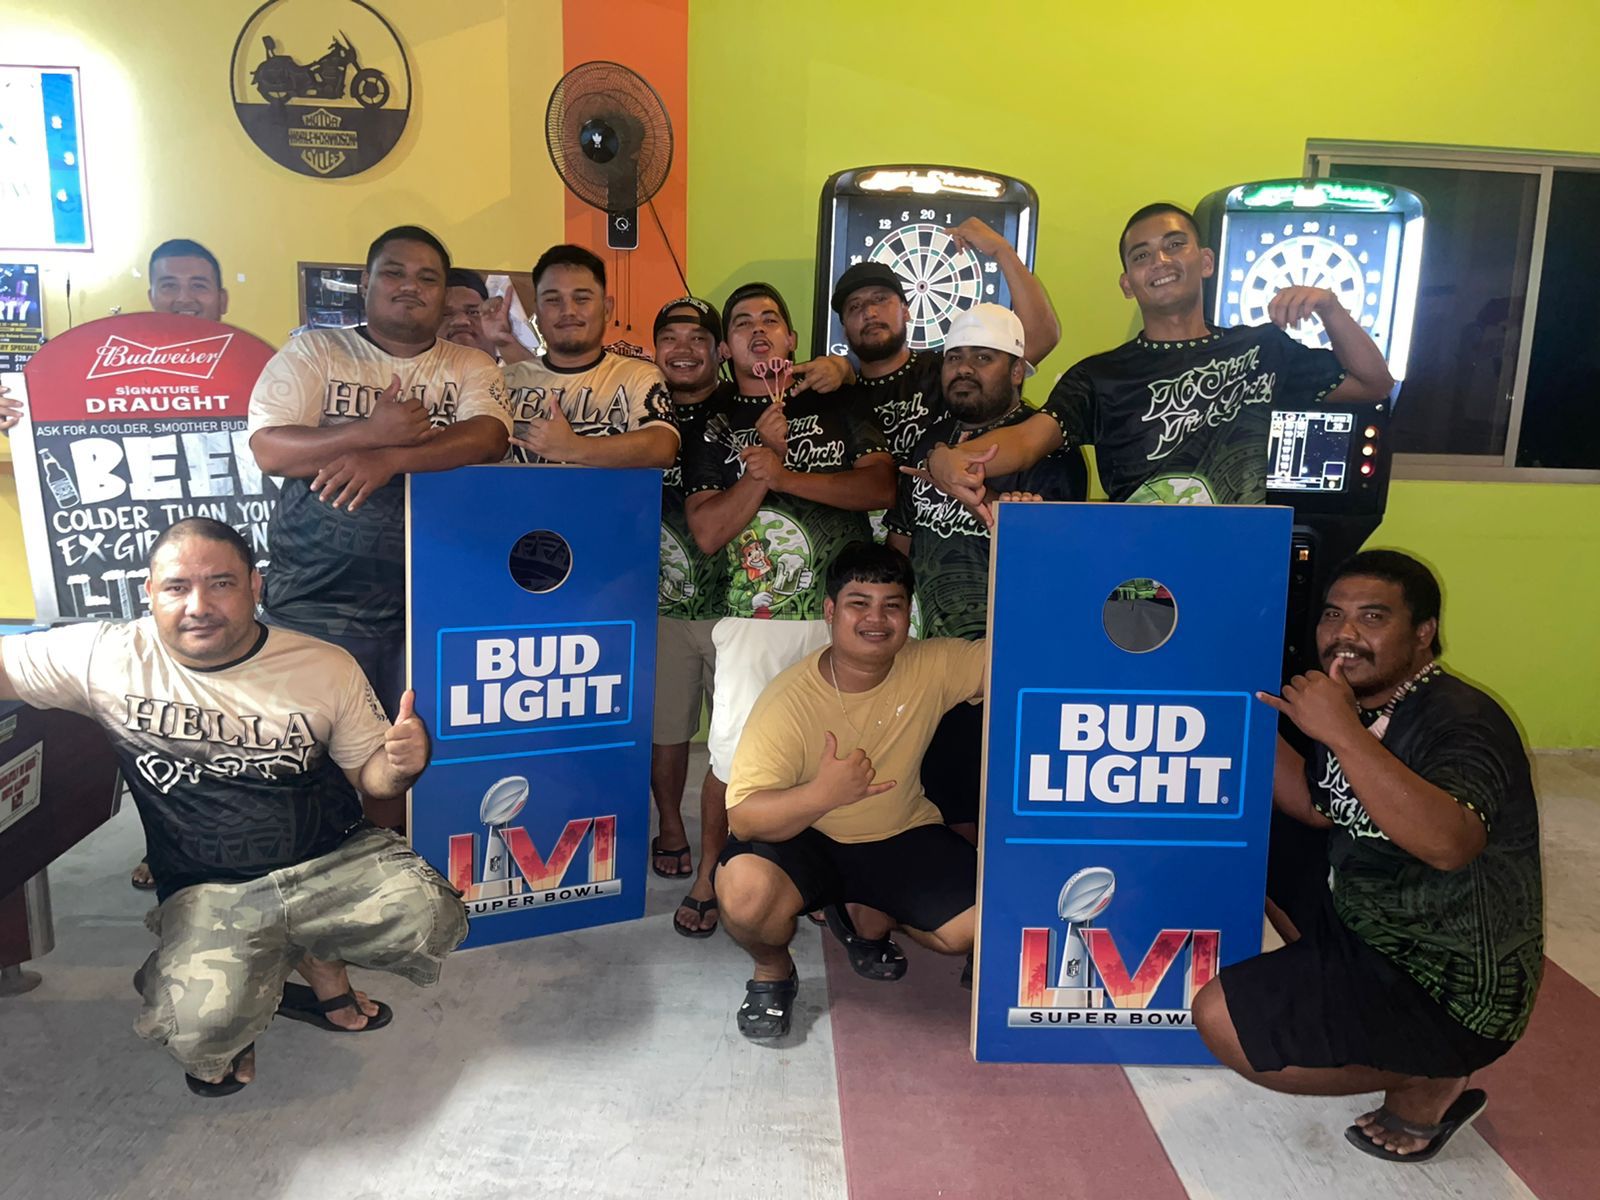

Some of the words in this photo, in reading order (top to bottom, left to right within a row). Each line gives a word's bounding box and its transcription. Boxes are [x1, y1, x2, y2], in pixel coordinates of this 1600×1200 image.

[879, 219, 892, 229] 12
[901, 212, 909, 221] 5
[920, 209, 935, 219] 20
[946, 213, 951, 223] 1
[865, 236, 873, 246] 9
[986, 283, 994, 294] 6
[96, 345, 219, 367] Budweiser
[86, 395, 230, 413] DRAUGHT
[115, 385, 200, 396] SIGNATURE
[37, 426, 60, 437] ASK
[63, 425, 87, 435] FOR
[90, 425, 98, 434] A
[100, 423, 152, 434] COLDER,
[154, 421, 218, 432] SMOOTHER
[53, 506, 148, 532] COLDER
[236, 500, 276, 522] YOU
[476, 635, 600, 680] BUD
[450, 675, 622, 727] LIGHT
[124, 694, 315, 750] HELLA
[1059, 704, 1206, 752] BUD
[1028, 755, 1232, 804] LIGHT
[449, 815, 617, 900] LVI
[465, 895, 535, 915] SUPER
[544, 885, 604, 903] BOWL
[1018, 927, 1221, 1009] LVI
[1030, 1012, 1118, 1025] SUPER
[1129, 1012, 1194, 1025] BOW
